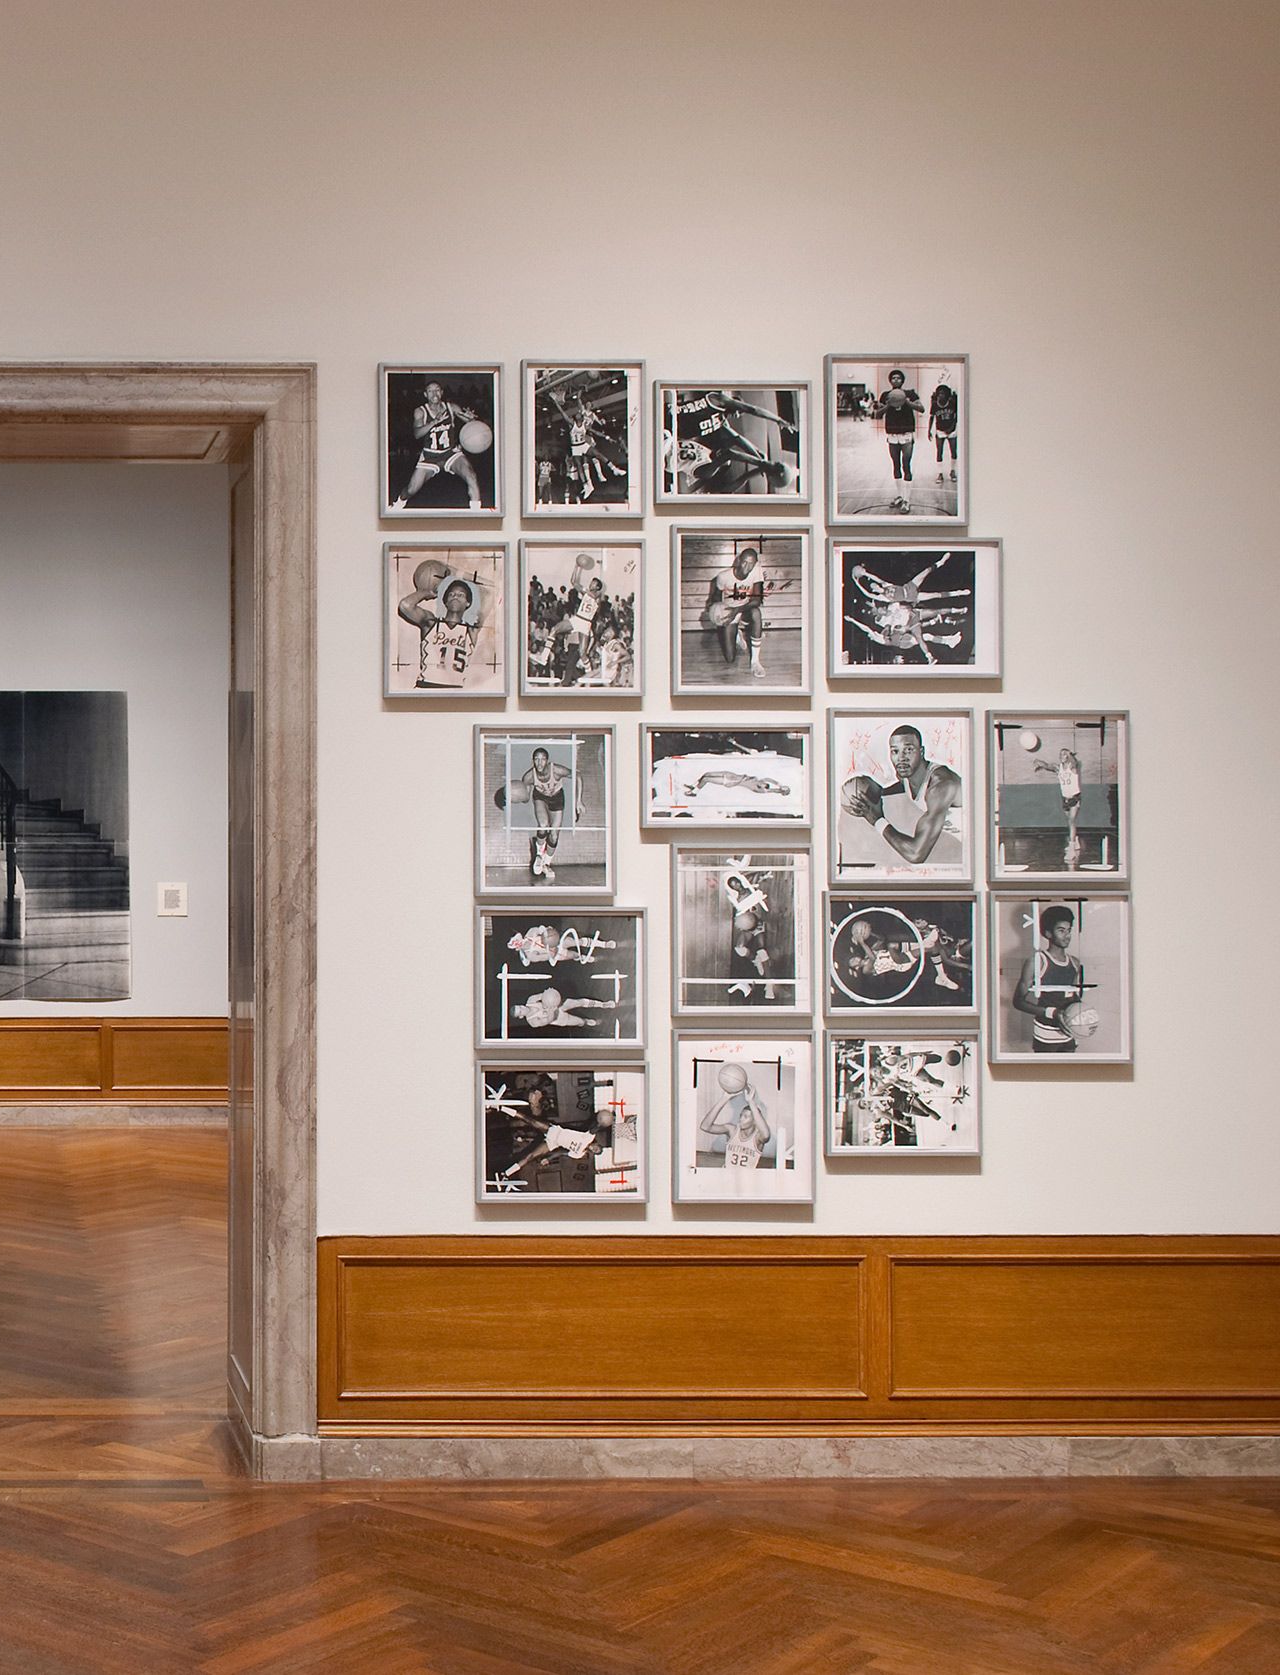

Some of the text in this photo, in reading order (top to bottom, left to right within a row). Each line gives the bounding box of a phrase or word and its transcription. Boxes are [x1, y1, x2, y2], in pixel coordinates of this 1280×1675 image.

[430, 431, 450, 450] 14
[677, 440, 697, 461] 33
[432, 632, 466, 648] Poets
[438, 647, 467, 673] 15
[731, 1153, 748, 1167] 32
